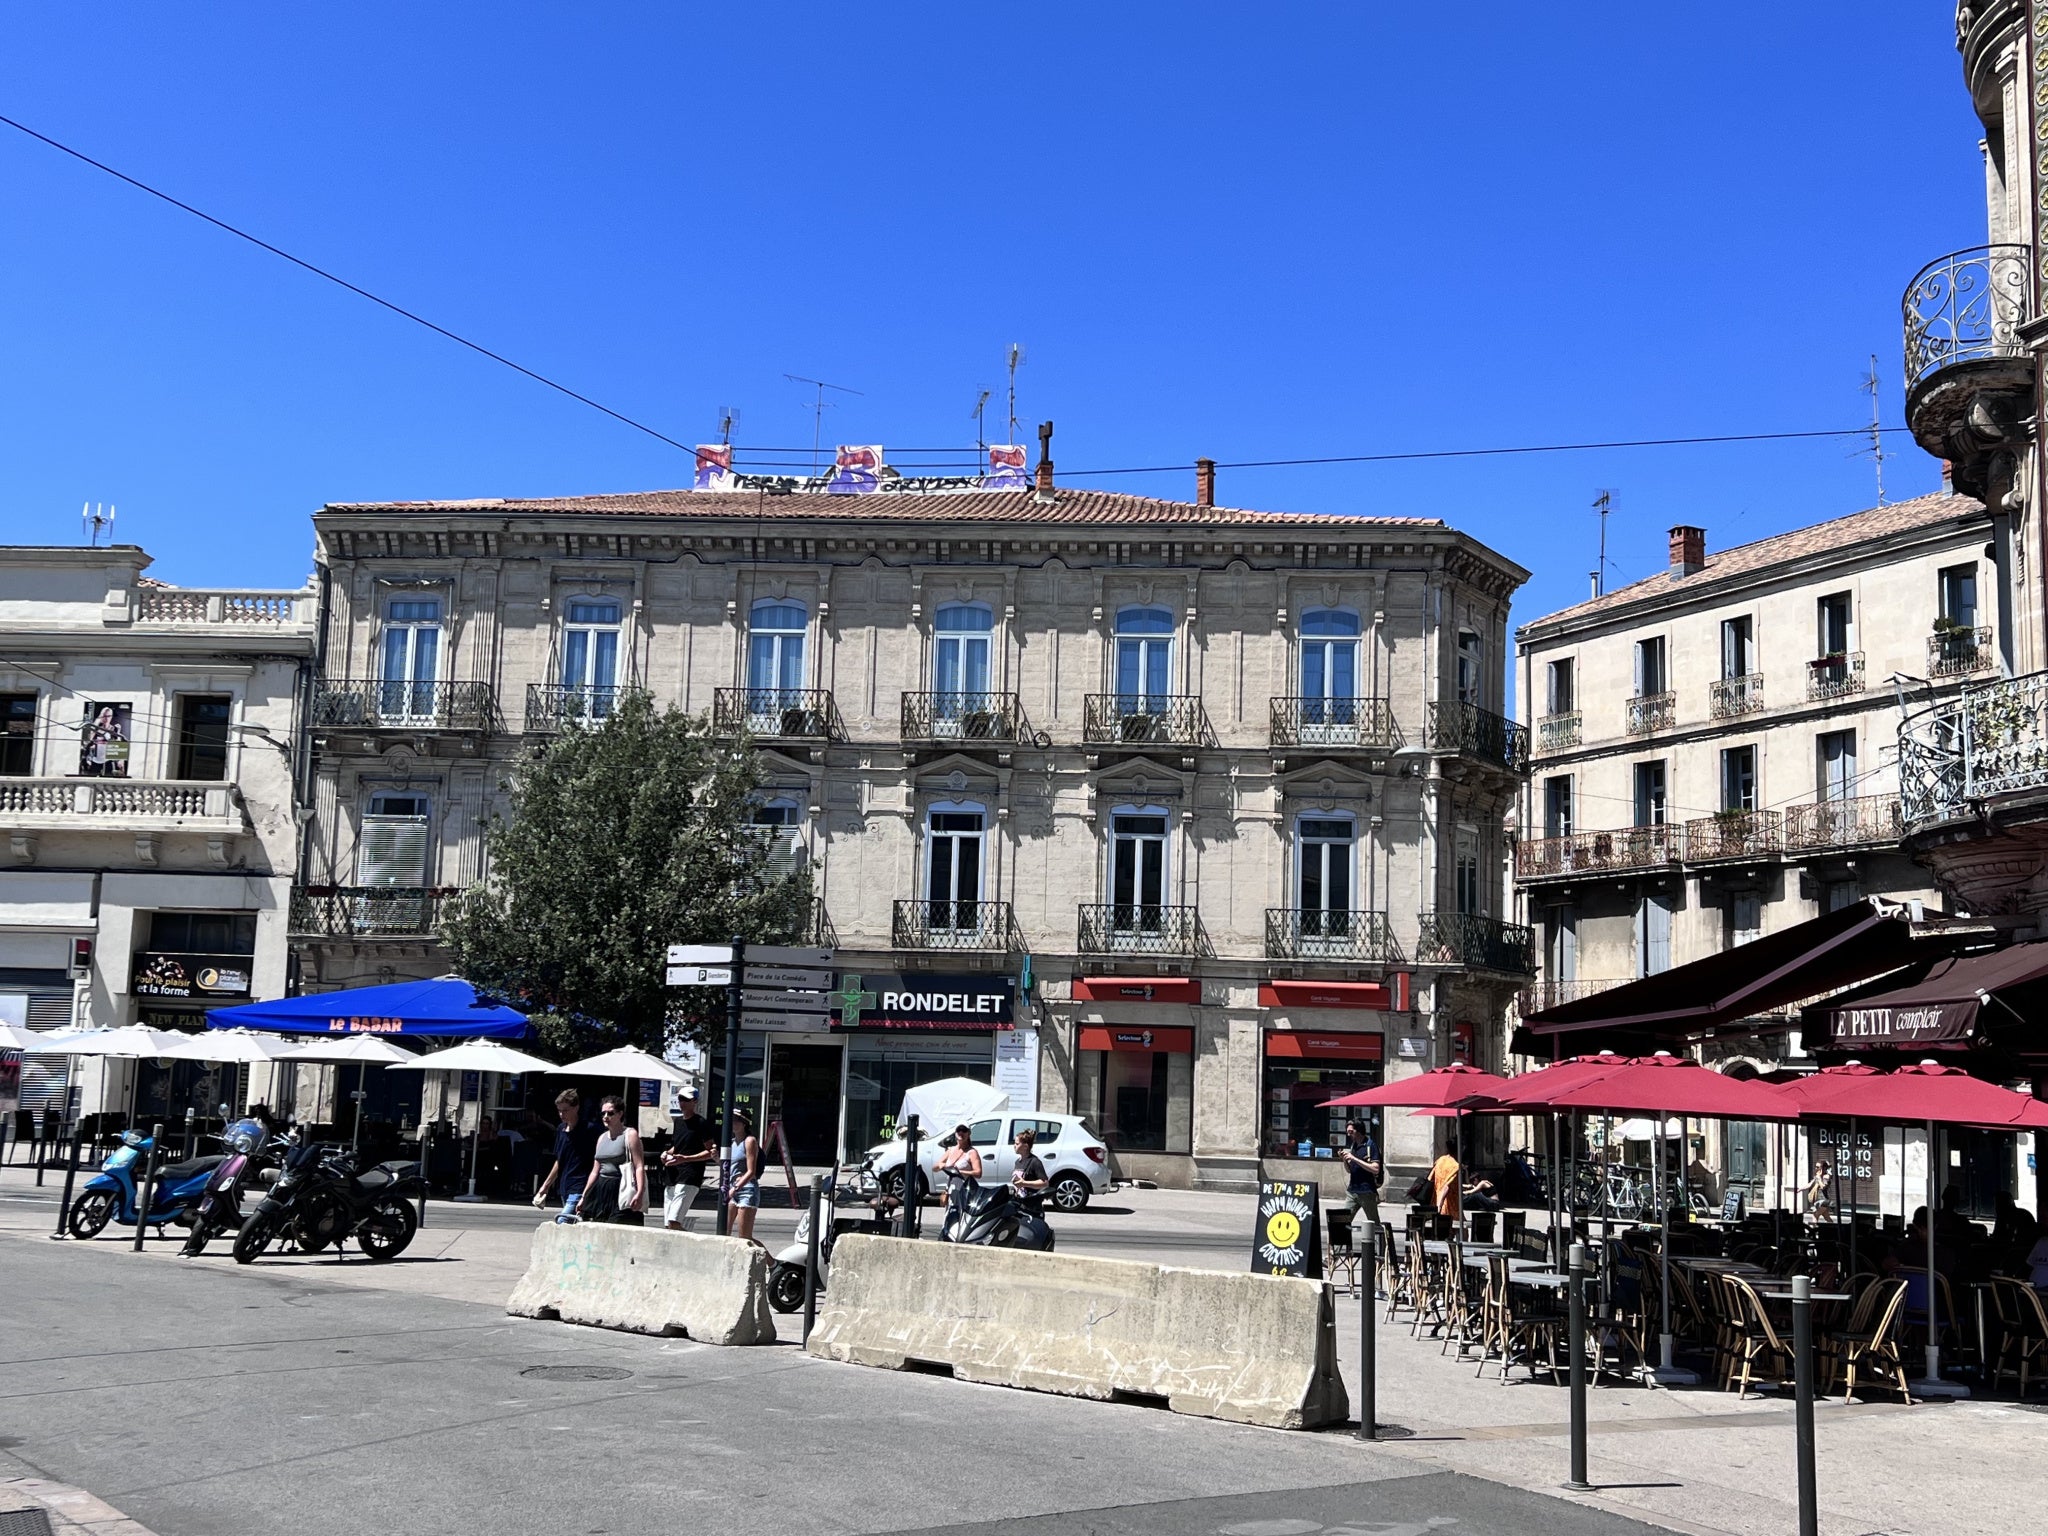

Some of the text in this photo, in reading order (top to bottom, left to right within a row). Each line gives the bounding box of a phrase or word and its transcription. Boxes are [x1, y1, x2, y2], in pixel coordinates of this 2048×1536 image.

[155, 975, 164, 984] le
[164, 976, 191, 987] plaisir
[781, 974, 807, 982] Comédie
[137, 984, 190, 996] et la forme
[883, 991, 1005, 1014] RONDELET
[148, 1013, 207, 1026] NEW PLAN
[349, 1016, 403, 1032] BABAR
[744, 1017, 787, 1026] Halles Laissac
[1830, 1011, 1846, 1037] LE
[1850, 1008, 1892, 1036] PETIT
[1819, 1128, 1872, 1148] Burgrs,
[1836, 1148, 1872, 1163] apro
[1263, 1183, 1272, 1194] DE
[1260, 1195, 1312, 1221] HAPPY HOURS
[1258, 1242, 1304, 1266] COCKTAILS
